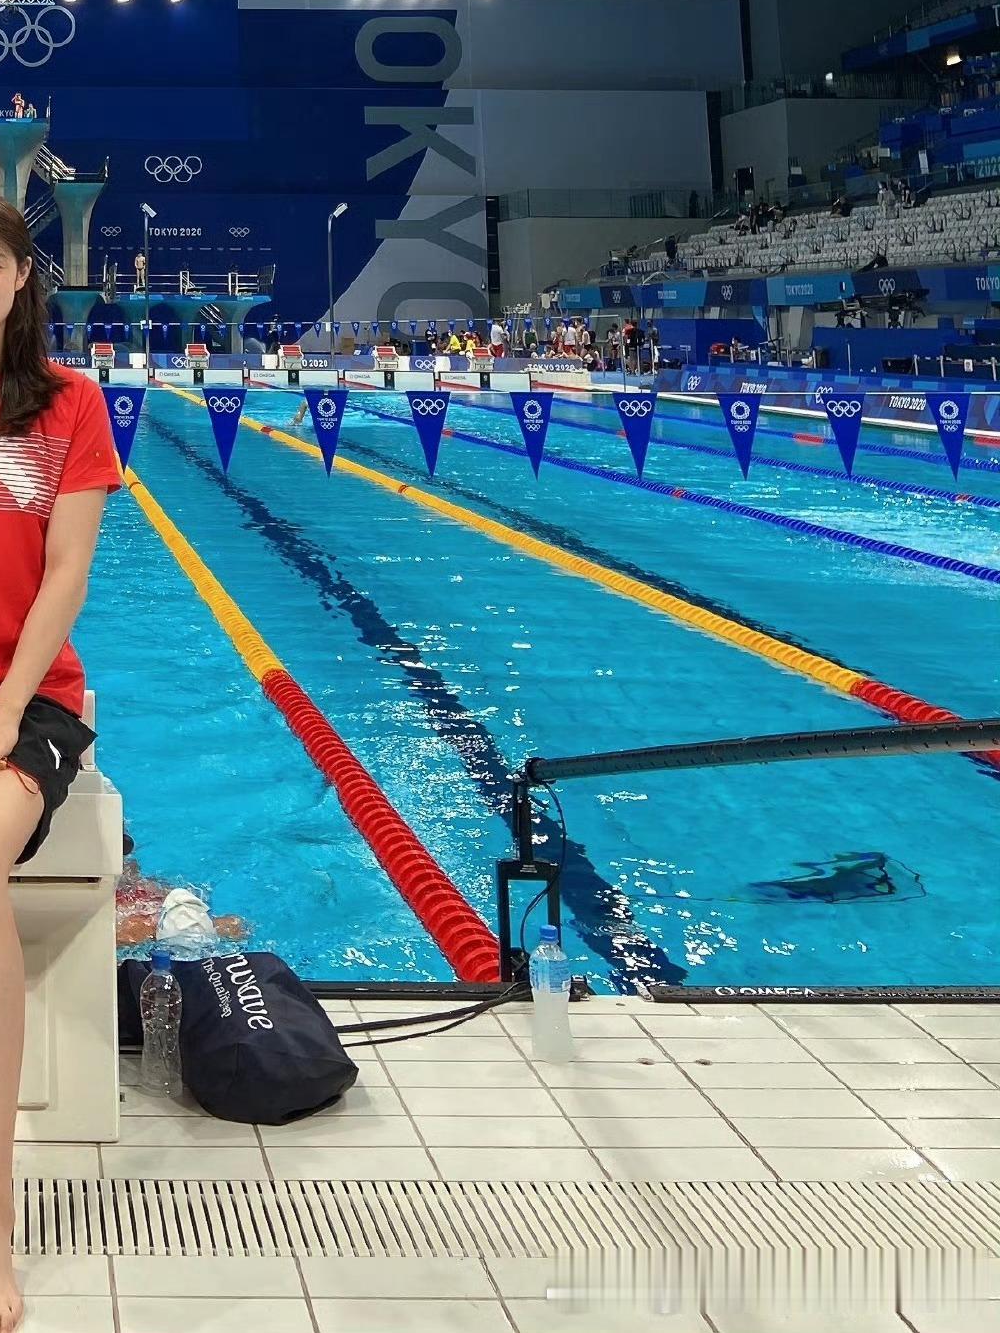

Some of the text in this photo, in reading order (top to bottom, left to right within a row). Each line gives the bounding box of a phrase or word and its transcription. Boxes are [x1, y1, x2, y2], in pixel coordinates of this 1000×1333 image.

[149, 227, 202, 237] TOKYO 2020
[309, 359, 328, 368] 2020
[888, 395, 927, 411] TOKYO 2020
[739, 987, 816, 997] OMEGA
